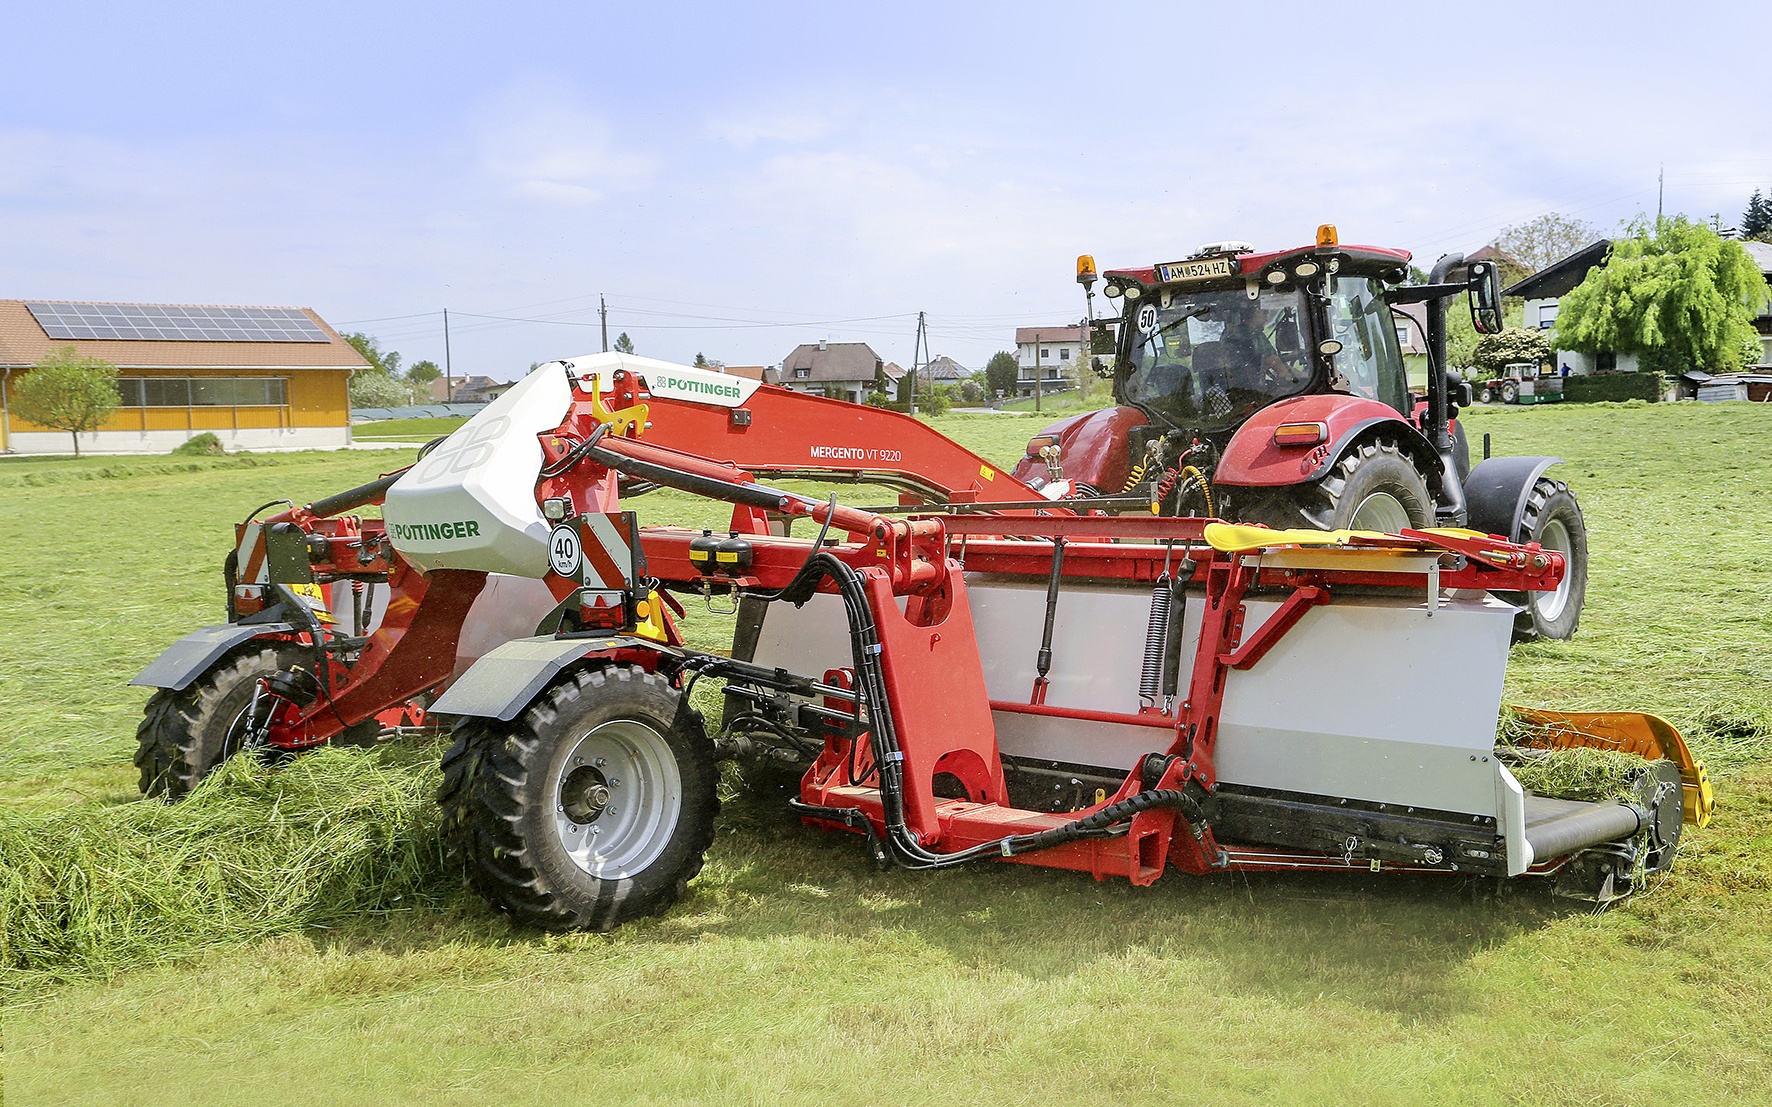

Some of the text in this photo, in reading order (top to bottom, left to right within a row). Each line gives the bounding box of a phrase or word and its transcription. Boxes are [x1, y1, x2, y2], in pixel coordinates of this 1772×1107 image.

[1171, 266, 1185, 279] AM
[1190, 264, 1211, 277] 524
[1212, 262, 1227, 275] HZ
[1140, 309, 1154, 328] 50
[810, 446, 902, 462] MERGENTO VT 9220
[555, 537, 574, 559] 40
[558, 560, 573, 568] km/h
